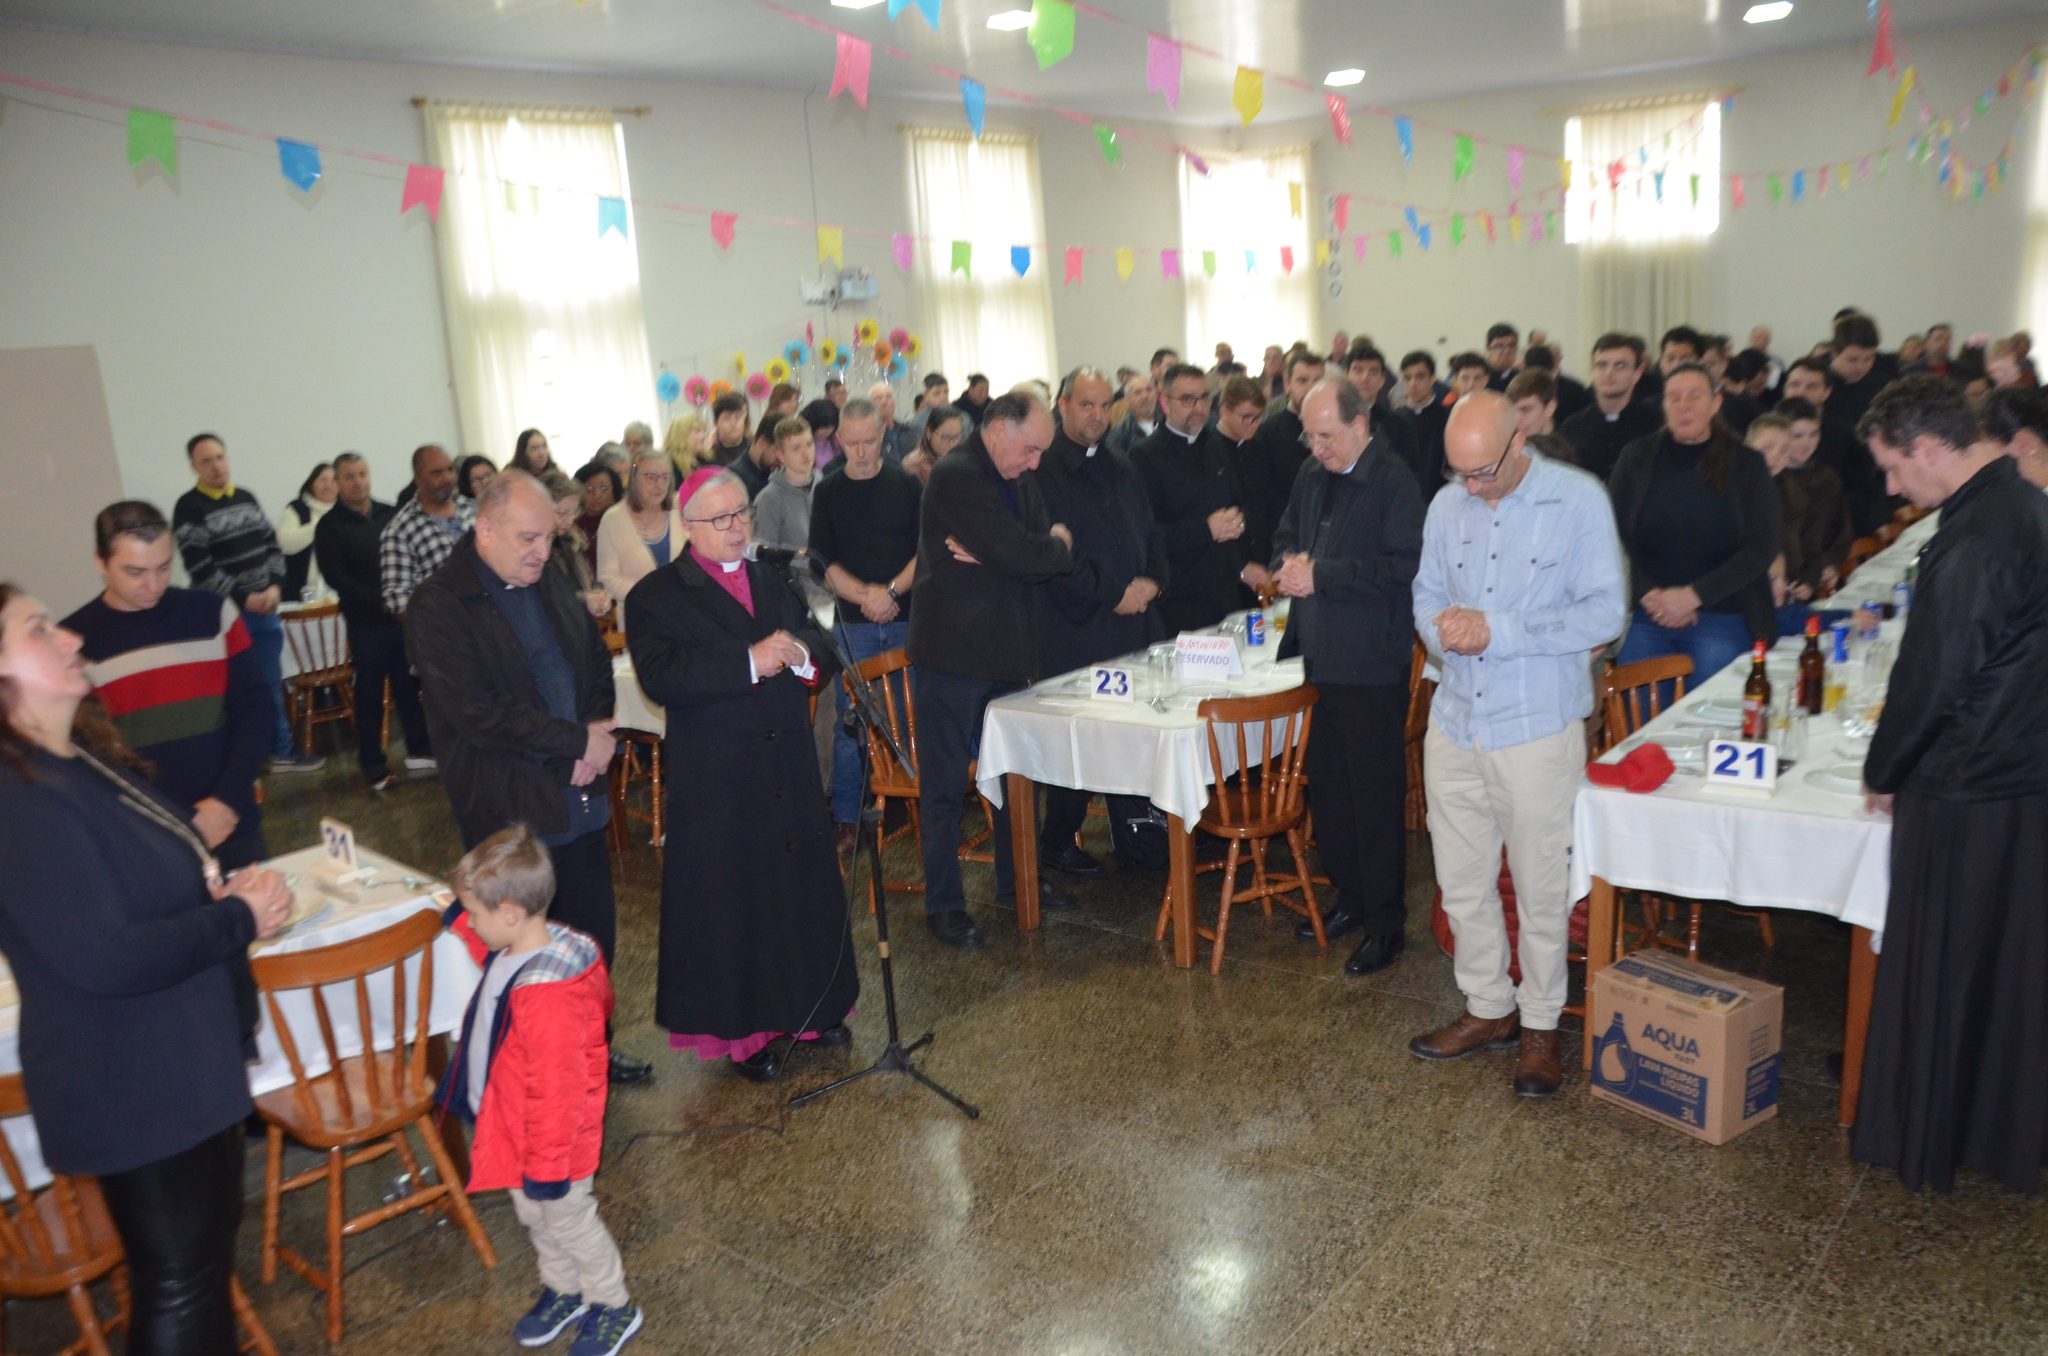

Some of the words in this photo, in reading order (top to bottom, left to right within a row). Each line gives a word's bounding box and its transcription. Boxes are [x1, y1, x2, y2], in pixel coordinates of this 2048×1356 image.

[1095, 669, 1128, 697] 23
[1713, 744, 1766, 779] 21
[1641, 1023, 1700, 1058] AQUA
[1680, 1106, 1698, 1124] 3L
